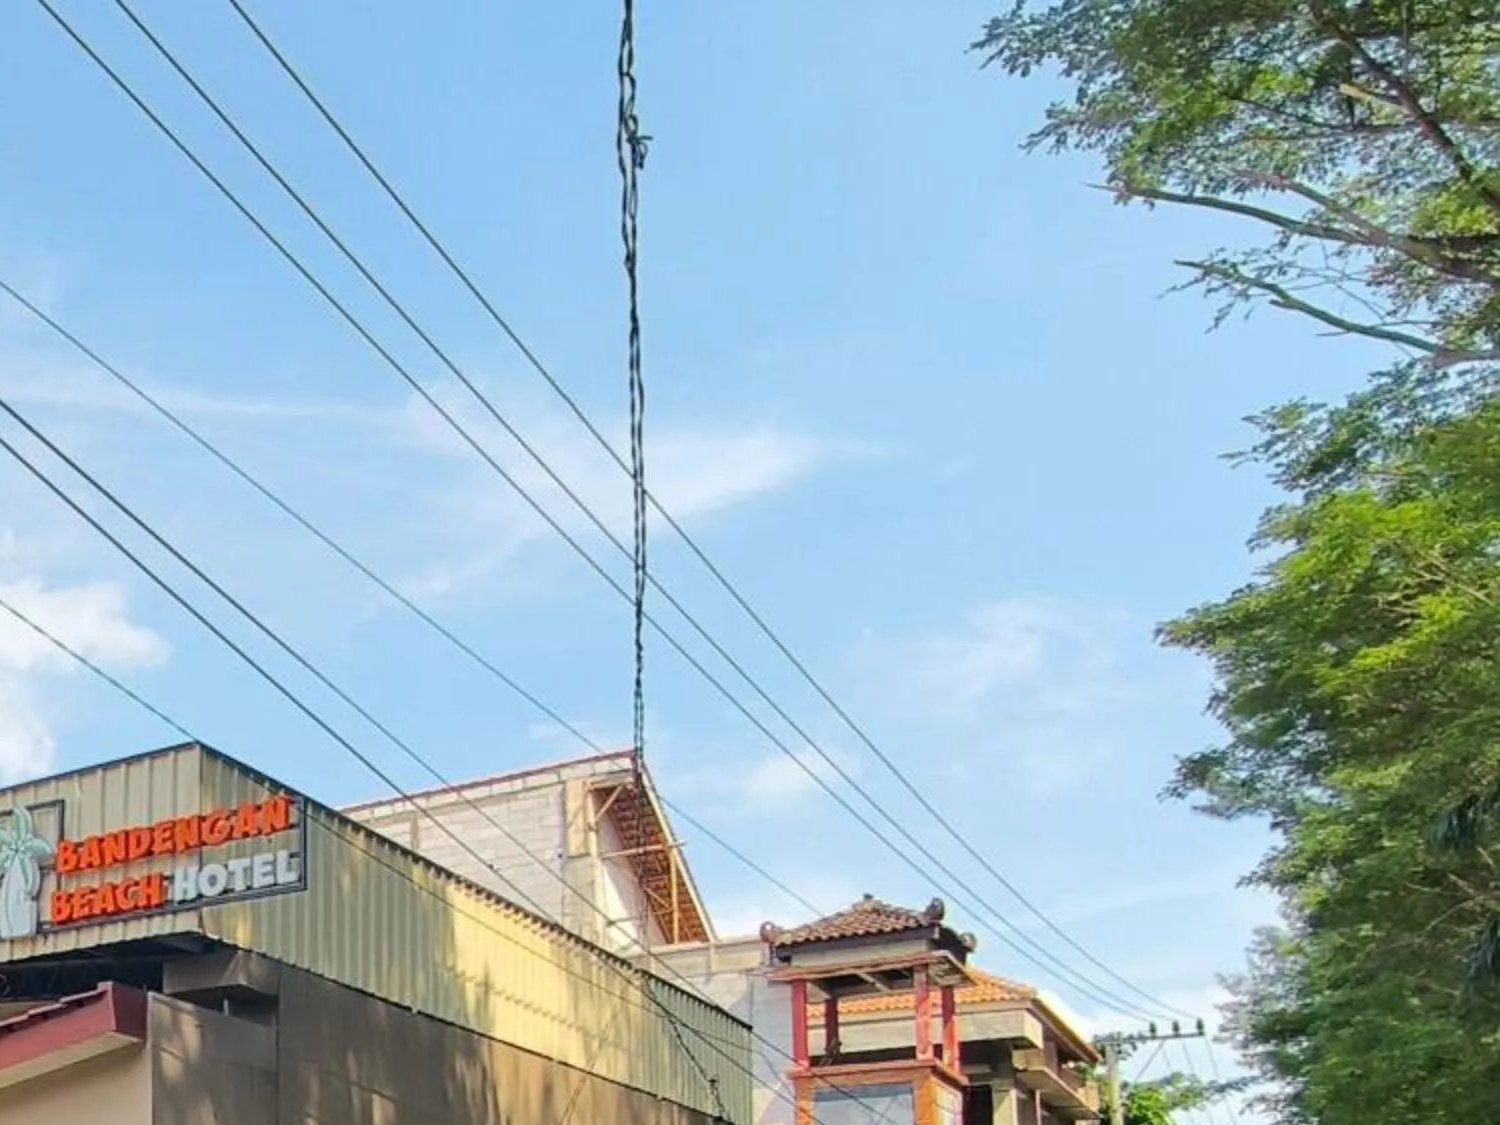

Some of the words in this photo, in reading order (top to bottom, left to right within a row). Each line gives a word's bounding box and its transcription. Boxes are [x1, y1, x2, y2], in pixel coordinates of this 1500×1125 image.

[56, 796, 292, 873] BANDENGAN
[52, 873, 167, 924] BEACH
[173, 850, 299, 902] HOTEL
